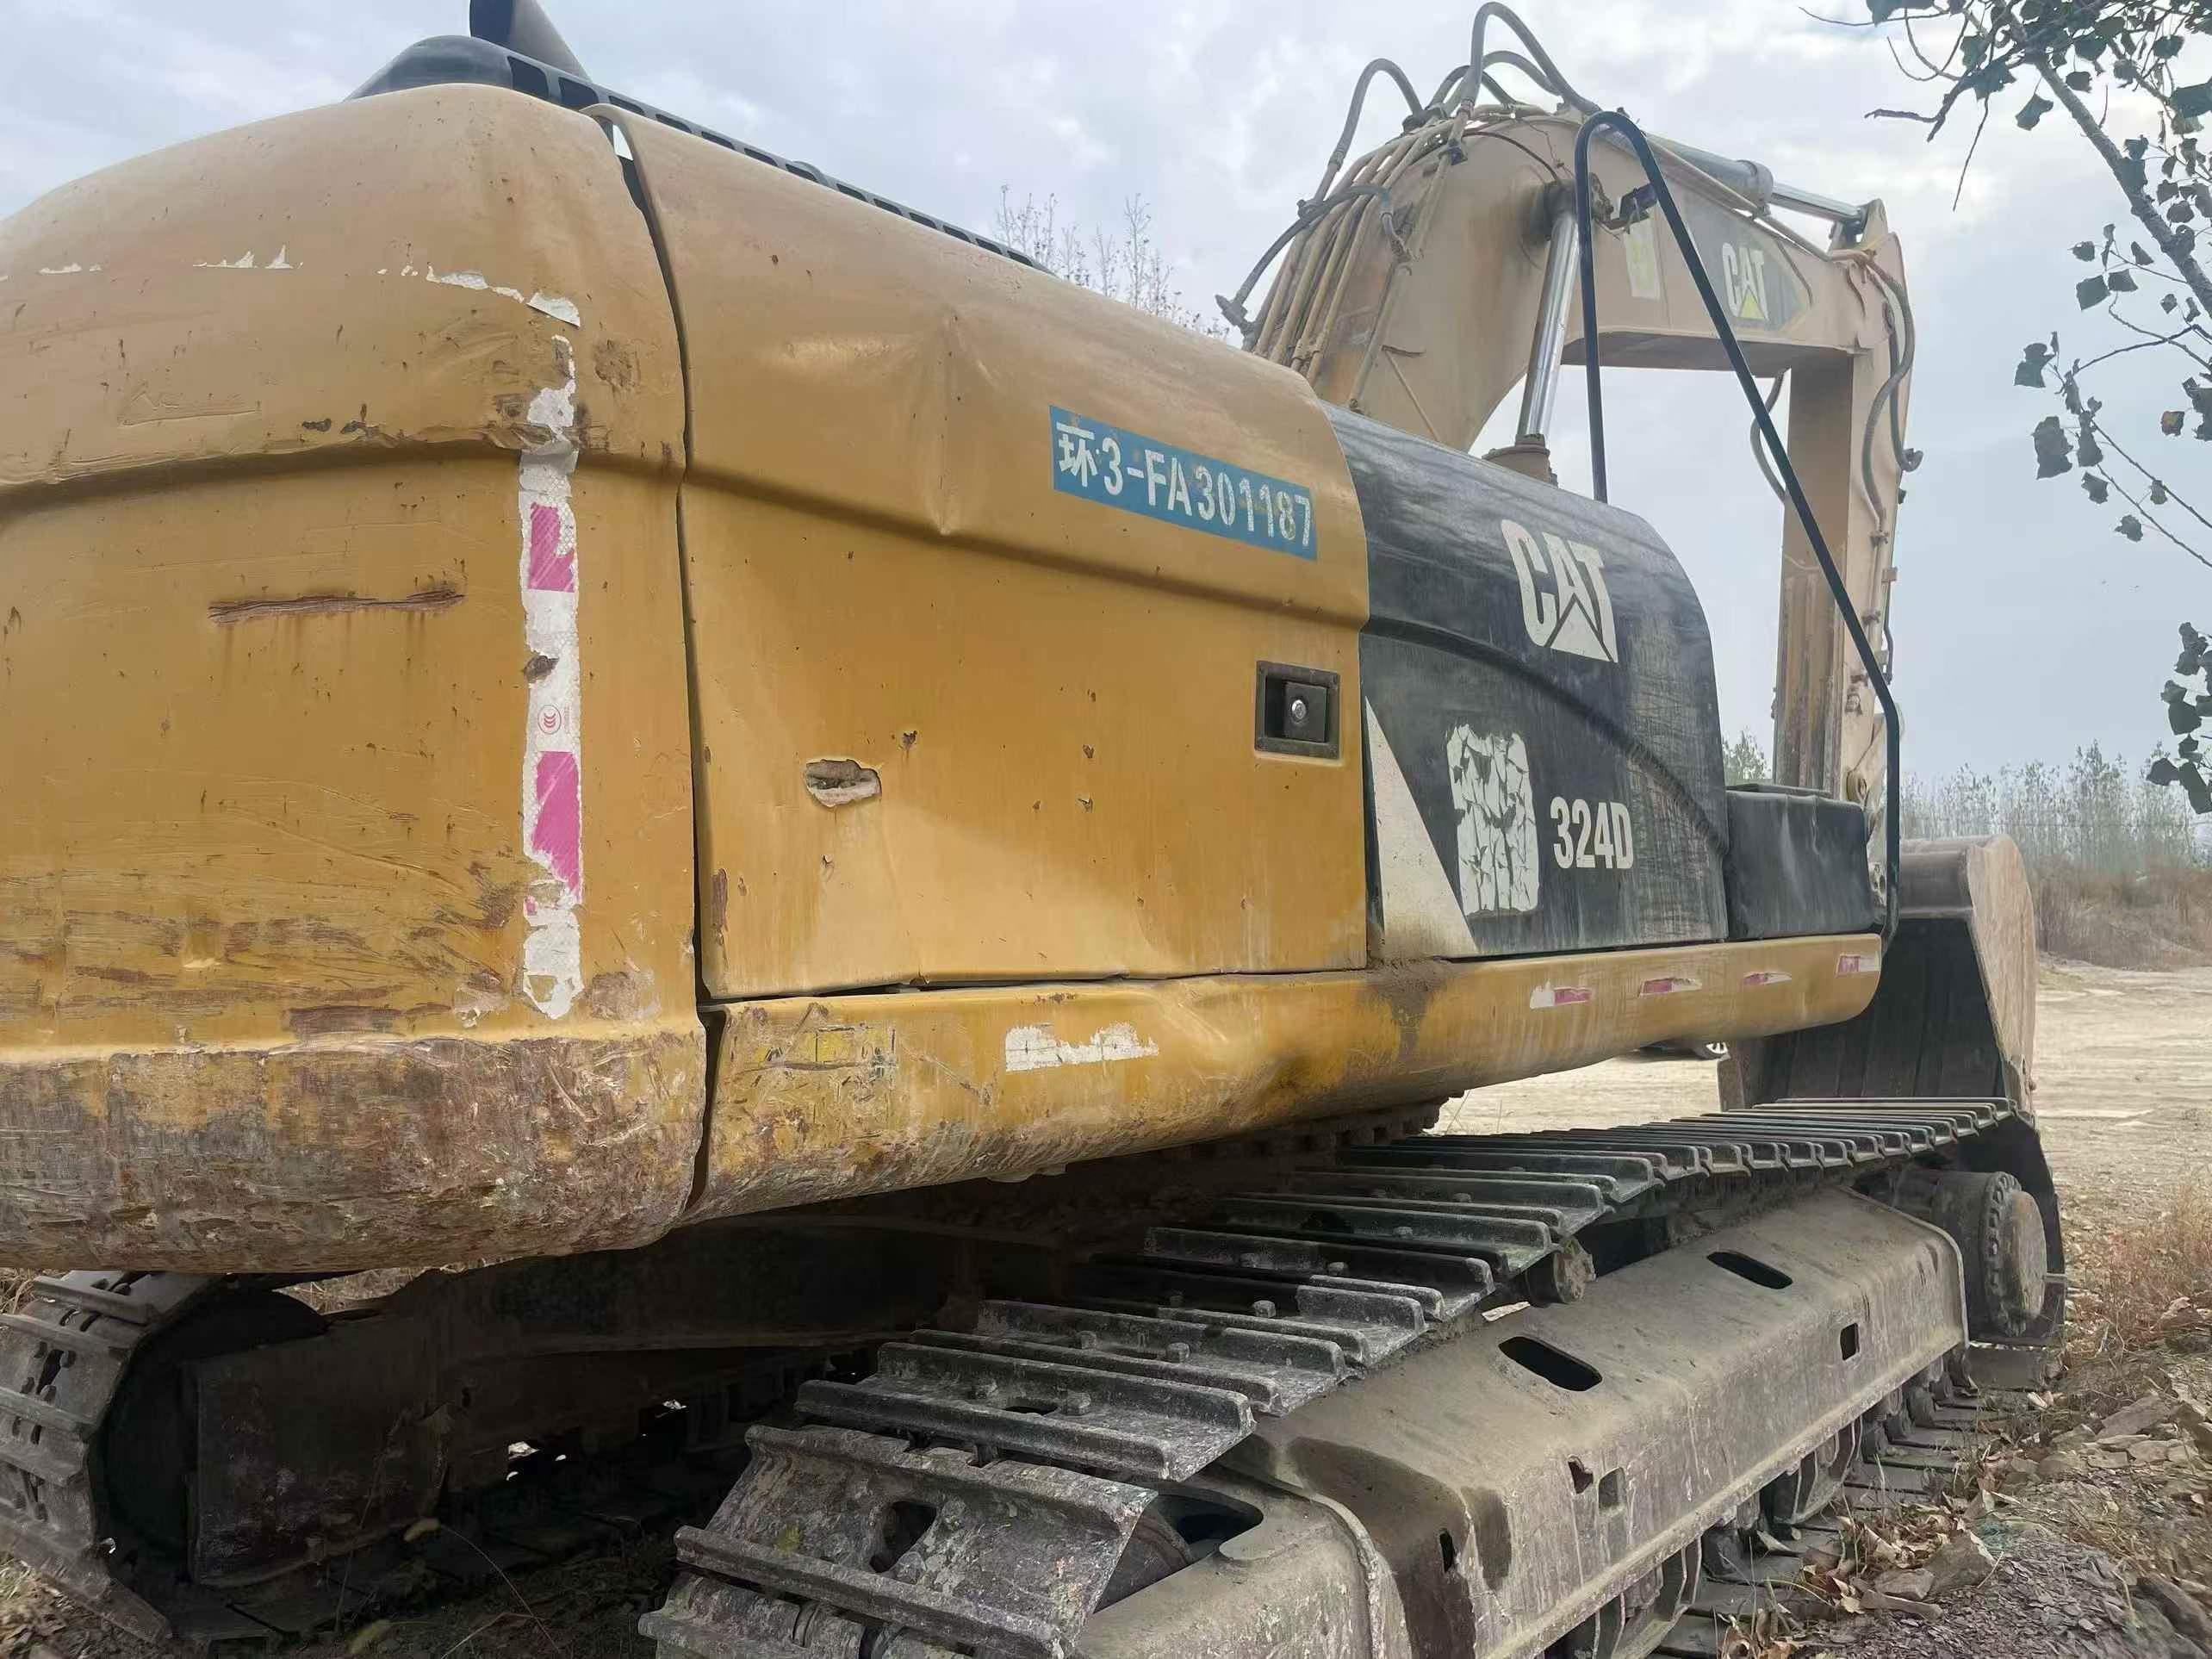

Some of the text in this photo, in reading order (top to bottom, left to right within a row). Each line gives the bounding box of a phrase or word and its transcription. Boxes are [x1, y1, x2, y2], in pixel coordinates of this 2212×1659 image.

[1723, 242, 1768, 320] CAT
[1501, 519, 1619, 662] CAT
[1551, 797, 1634, 869] 324D
